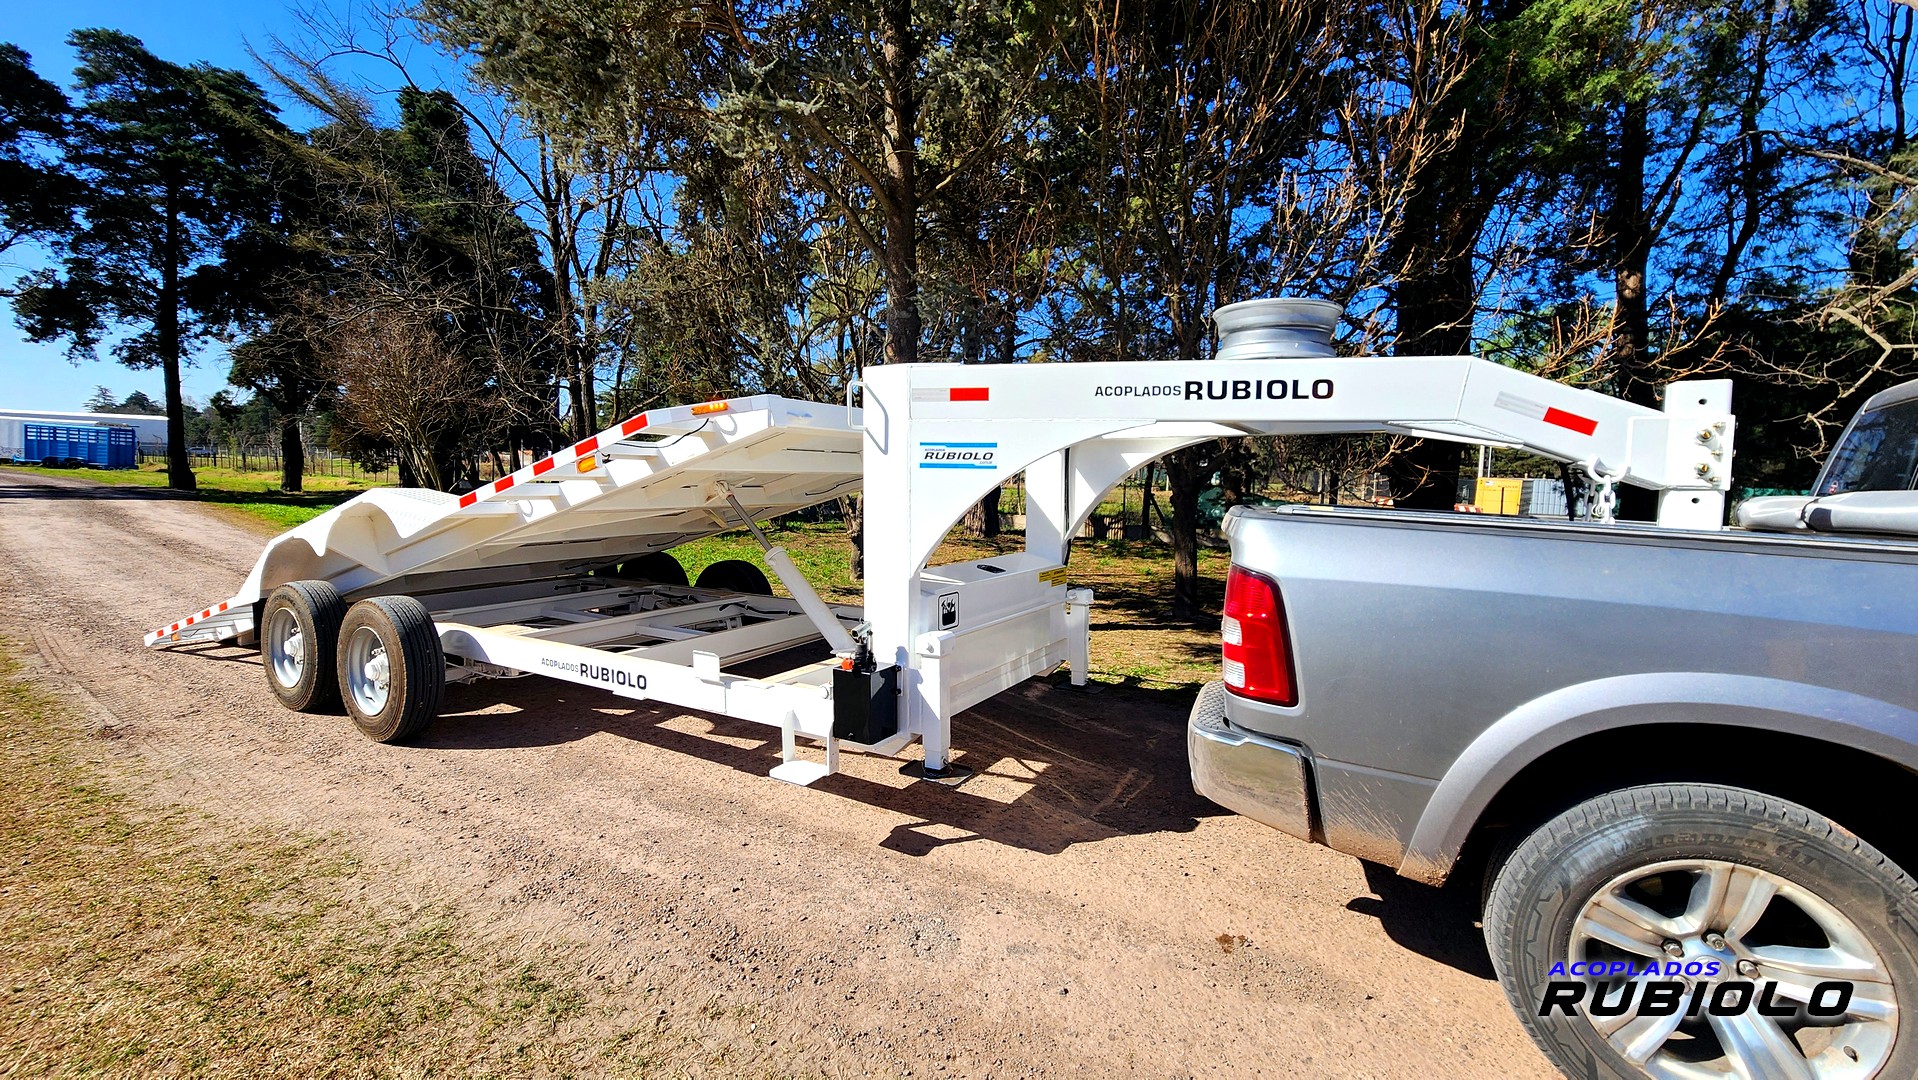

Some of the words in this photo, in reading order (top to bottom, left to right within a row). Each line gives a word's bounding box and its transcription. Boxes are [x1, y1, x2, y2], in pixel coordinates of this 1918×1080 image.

[1095, 385, 1181, 397] ACOPLADOS
[1184, 379, 1334, 400] RUBIOLO
[924, 452, 994, 460] RUBIOLO
[541, 658, 579, 672] ACOPLADOS
[580, 663, 647, 690] RUBIOLO
